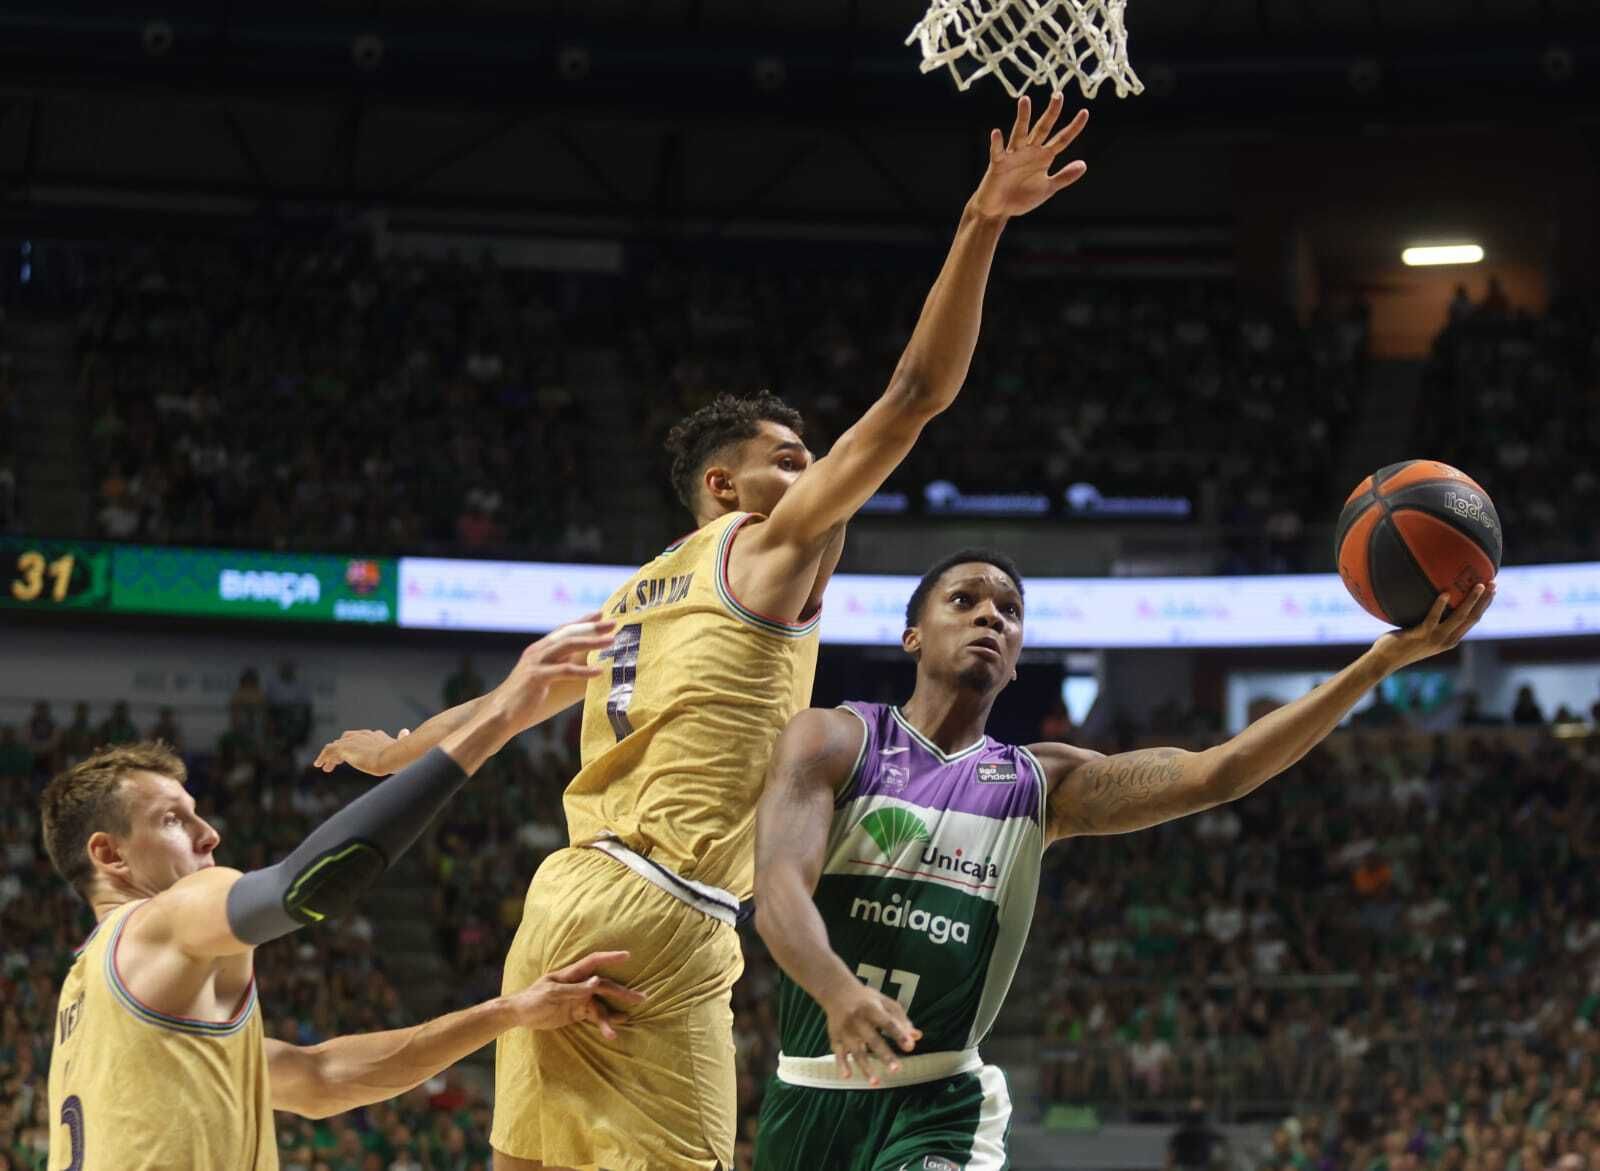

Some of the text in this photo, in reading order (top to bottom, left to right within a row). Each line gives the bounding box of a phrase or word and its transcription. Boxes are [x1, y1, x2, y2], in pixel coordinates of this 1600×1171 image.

[12, 551, 75, 602] 31
[635, 572, 695, 612] SILVA
[920, 847, 998, 882] Unicaja
